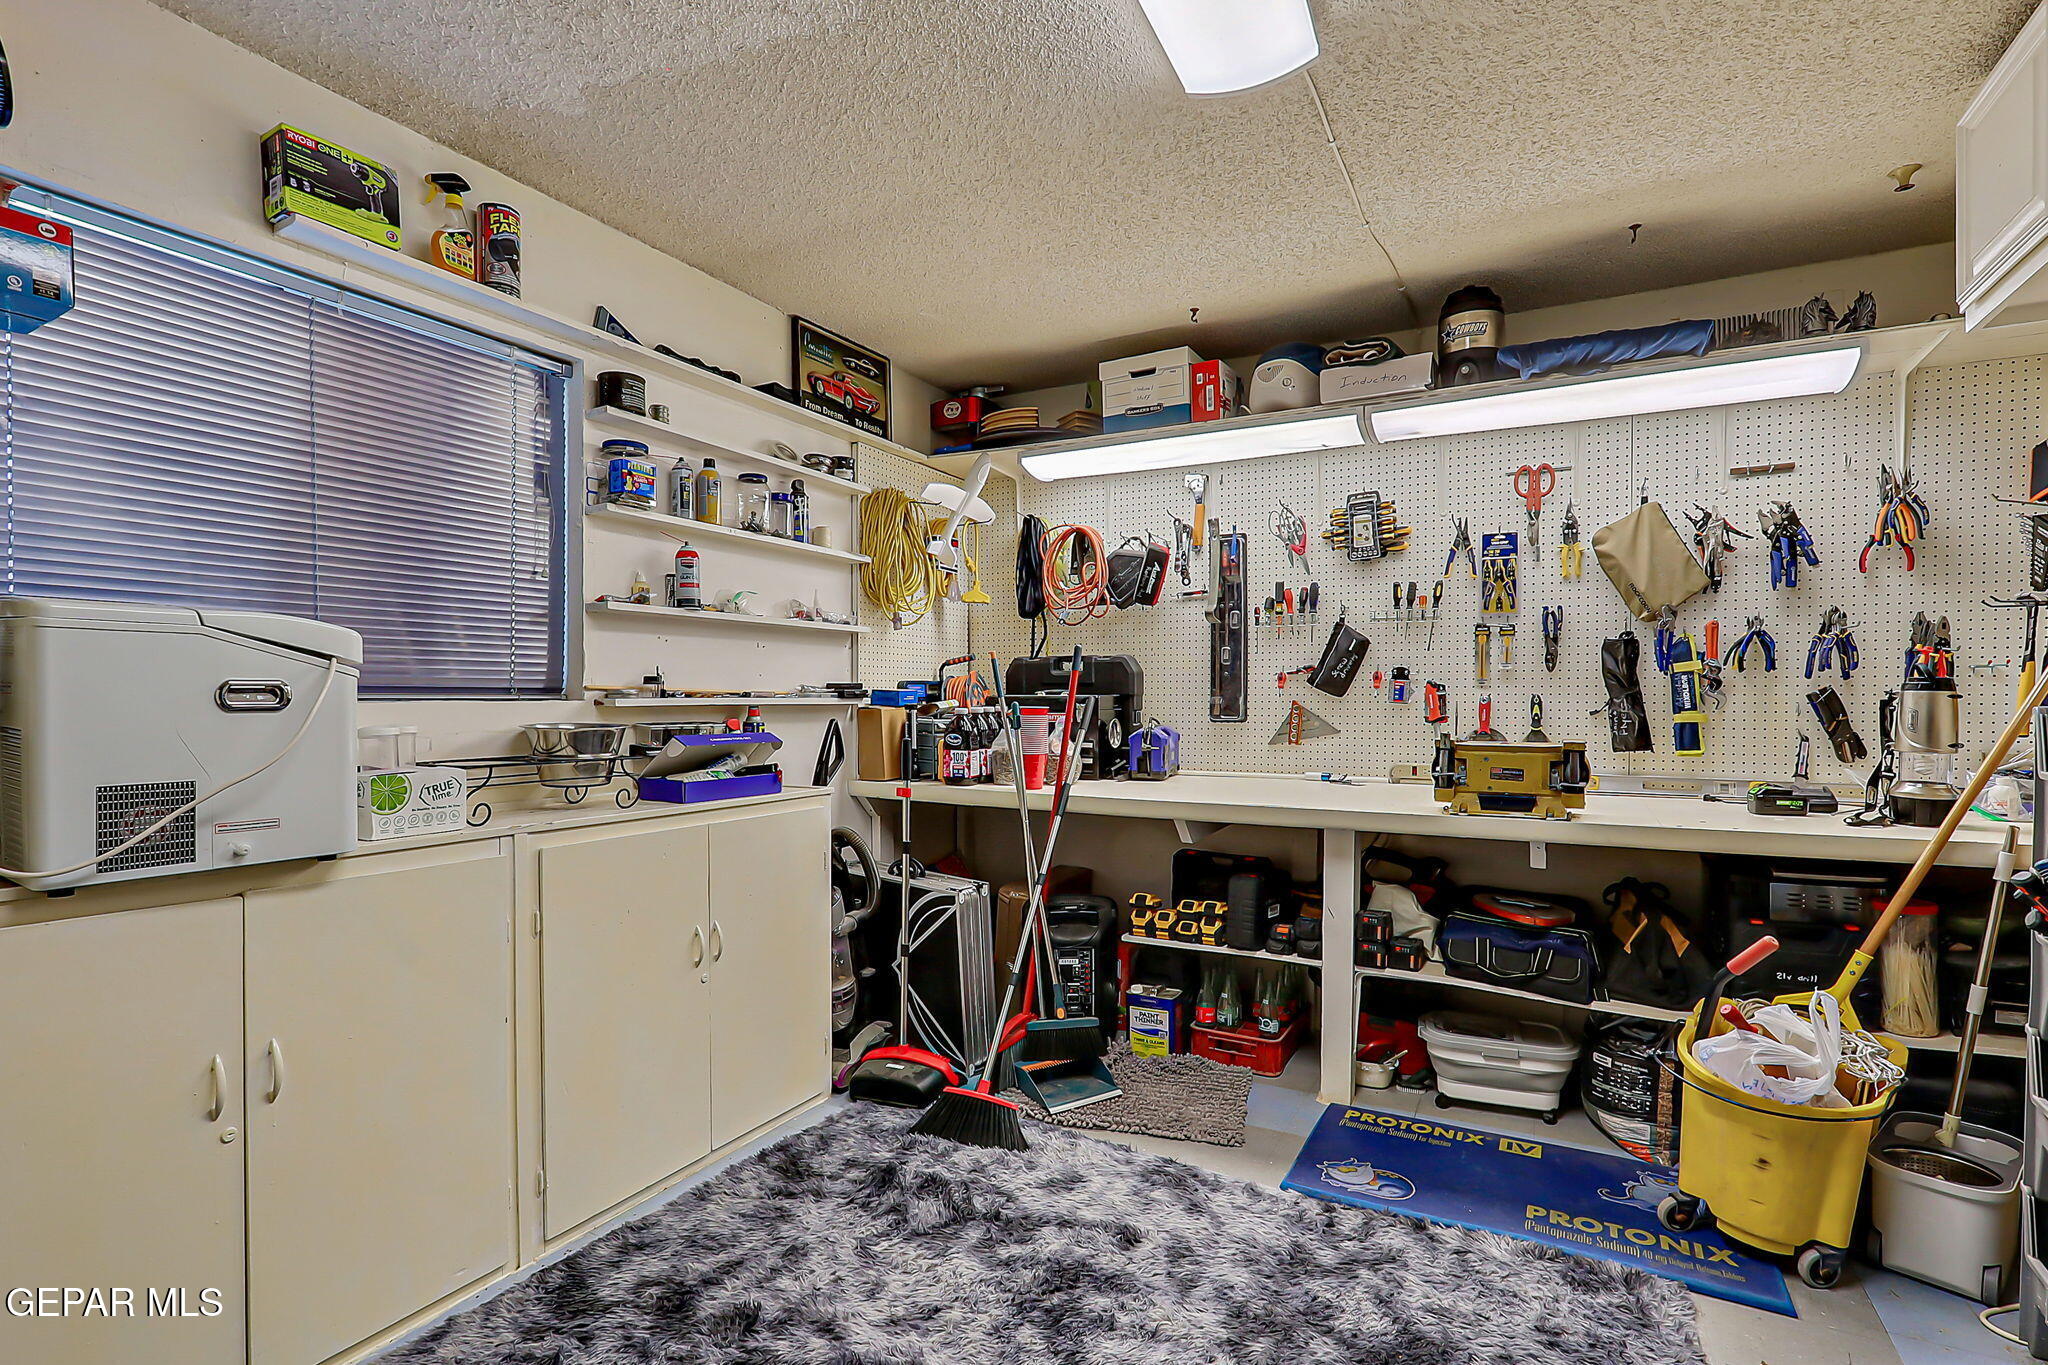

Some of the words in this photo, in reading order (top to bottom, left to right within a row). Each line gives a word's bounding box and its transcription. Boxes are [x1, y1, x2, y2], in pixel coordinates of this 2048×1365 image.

[286, 130, 316, 149] RYOBI
[1454, 321, 1488, 335] COWBOYS
[1339, 373, 1408, 389] Induction
[805, 399, 822, 413] From
[854, 417, 863, 428] To
[863, 421, 883, 437] Reality
[424, 779, 455, 797] TRUE
[431, 790, 452, 802] lime
[1133, 1015, 1164, 1026] THINNER
[1139, 1011, 1160, 1019] PAINT
[1344, 1109, 1485, 1145] PROTONIX
[1506, 1141, 1536, 1156] IV
[1387, 1127, 1418, 1142] Sodium)
[1524, 1219, 1593, 1245] (Pantoprazole
[1596, 1235, 1640, 1258] Sodium)
[1525, 1204, 1740, 1268] PROTONIX
